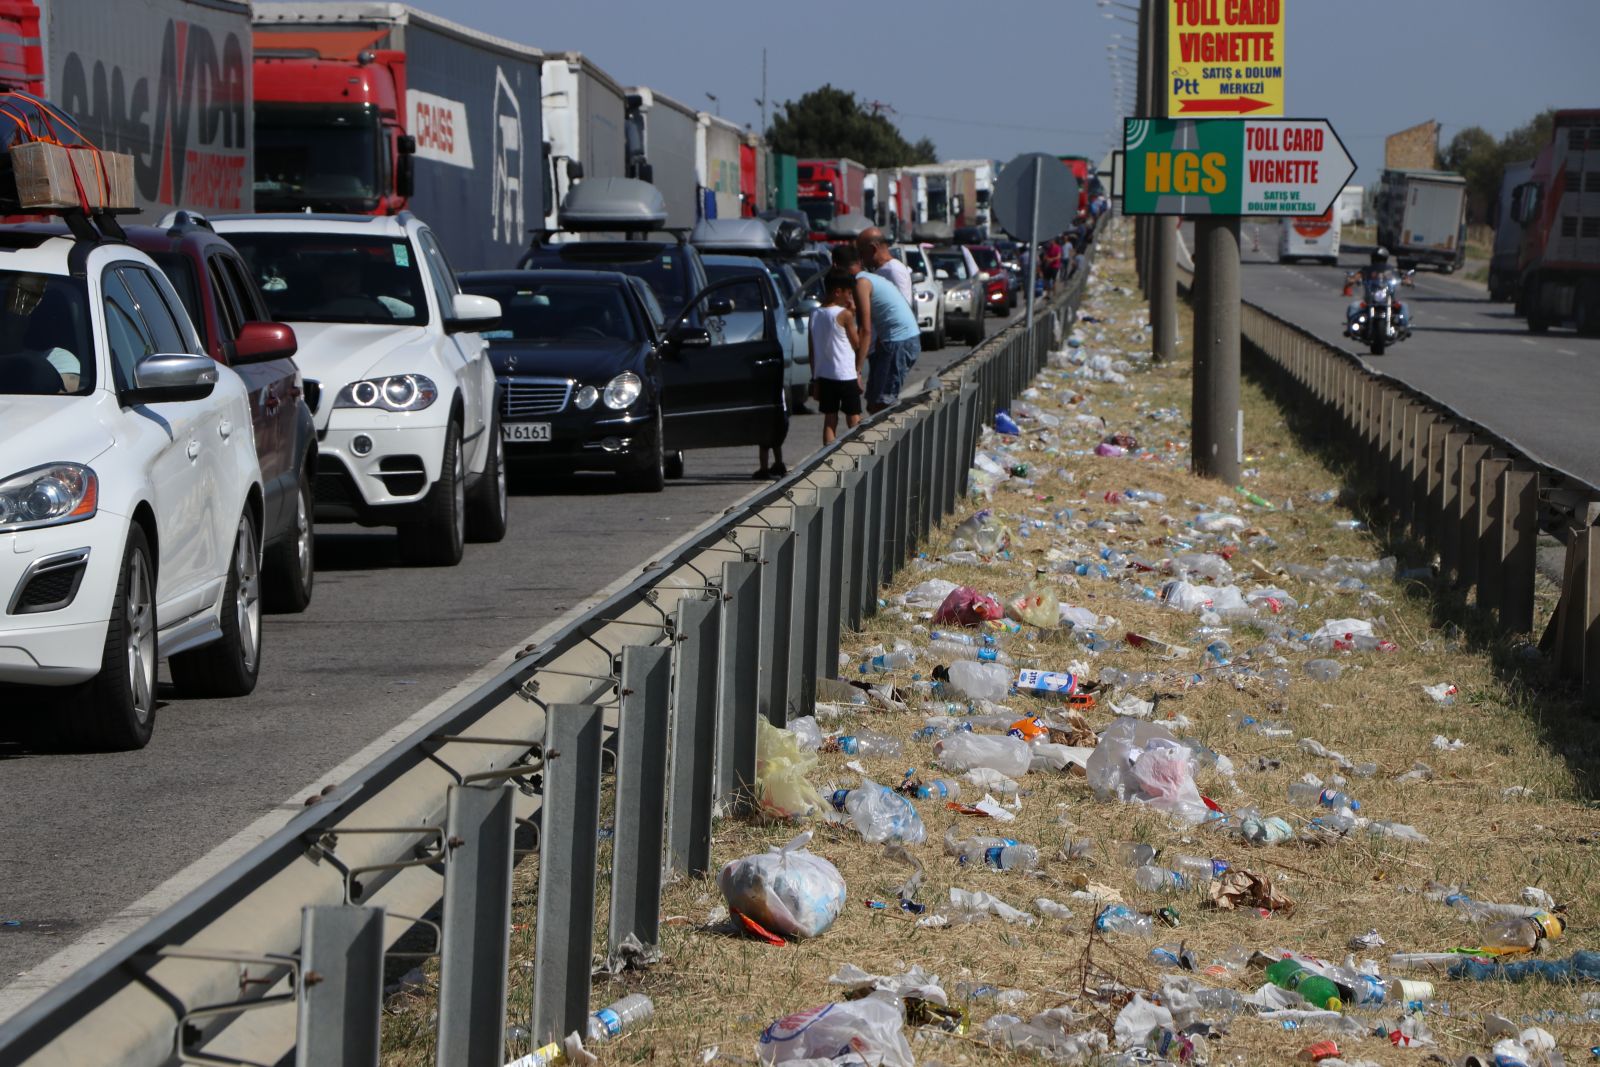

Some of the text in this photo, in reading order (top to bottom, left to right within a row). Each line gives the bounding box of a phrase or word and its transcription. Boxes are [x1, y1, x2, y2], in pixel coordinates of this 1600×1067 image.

[1174, 0, 1280, 26] TOLL CARD
[1179, 32, 1274, 63] VIGNETTE
[1202, 66, 1282, 81] SATIŞ & DOLUM
[1174, 78, 1200, 95] Ptt
[1220, 81, 1264, 95] MERKEZİ
[416, 101, 454, 154] CRAISS
[1246, 127, 1324, 152] TOLL CARD
[1144, 152, 1227, 194] HGS
[1249, 160, 1319, 184] VIGNETTE
[1248, 202, 1317, 212] DOLUM NOKTASI
[1264, 191, 1301, 201] SATIŞ VE
